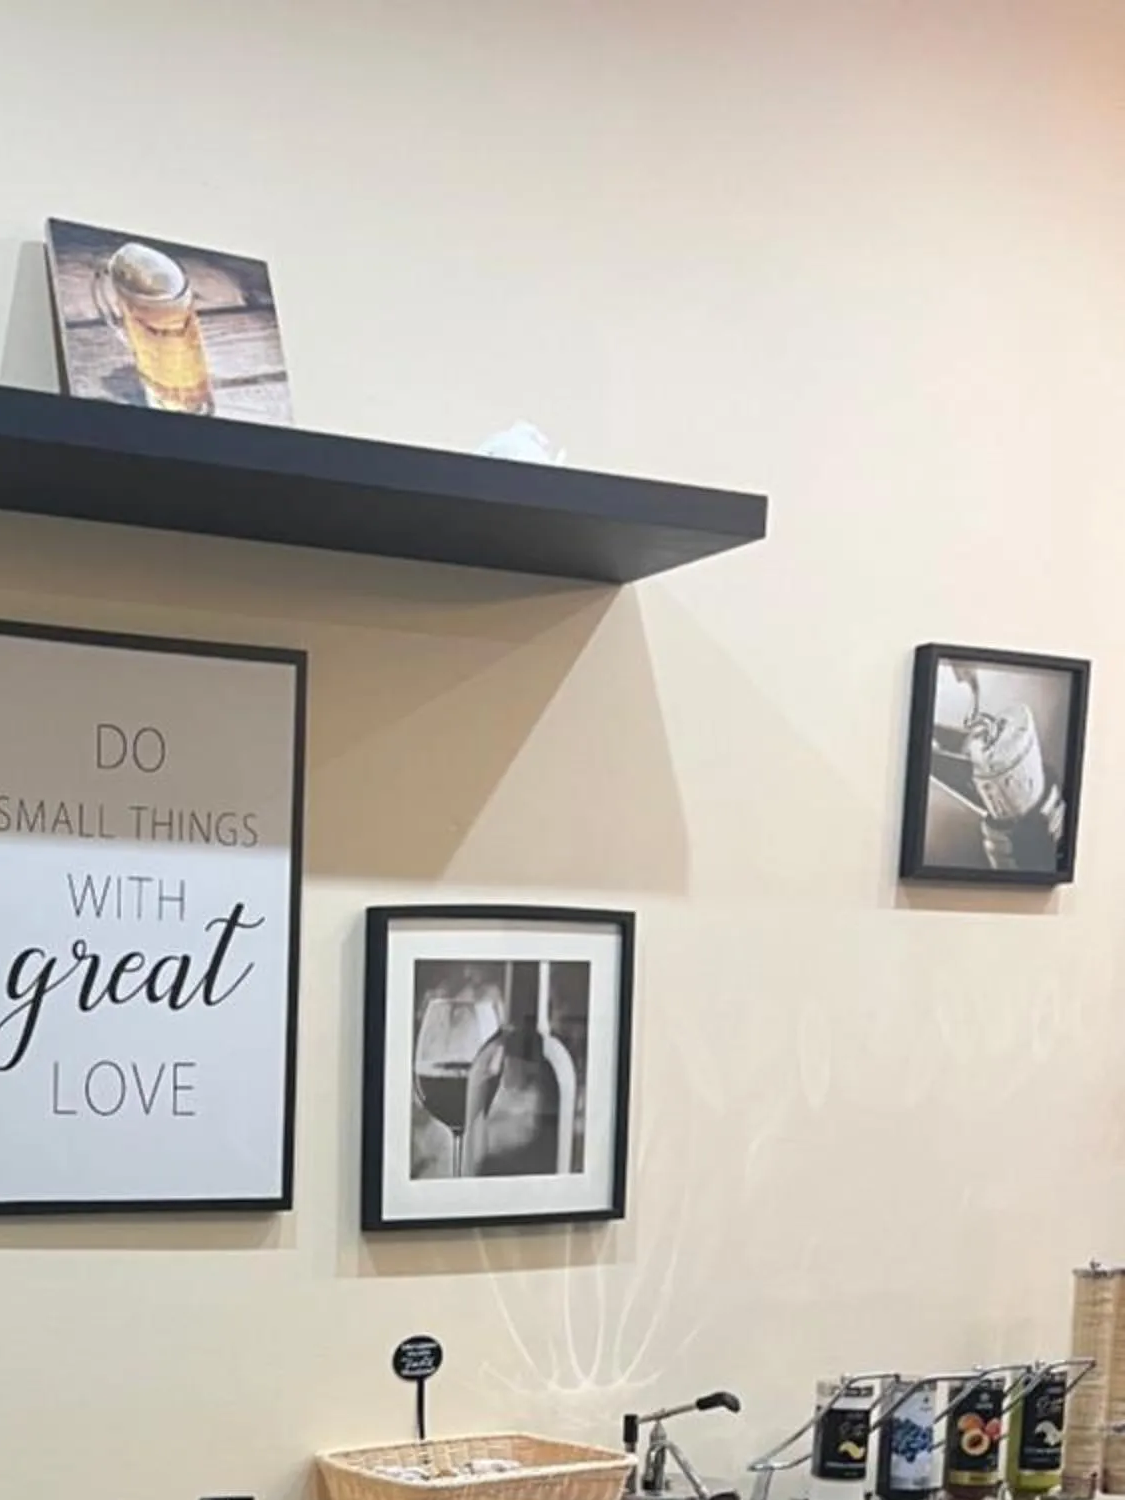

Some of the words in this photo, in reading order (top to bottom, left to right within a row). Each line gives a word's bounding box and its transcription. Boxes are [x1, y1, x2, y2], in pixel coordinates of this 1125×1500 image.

[96, 723, 166, 773] DO
[129, 806, 259, 847] THINGS
[66, 873, 186, 921] WITH
[52, 1060, 197, 1117] LOVE
